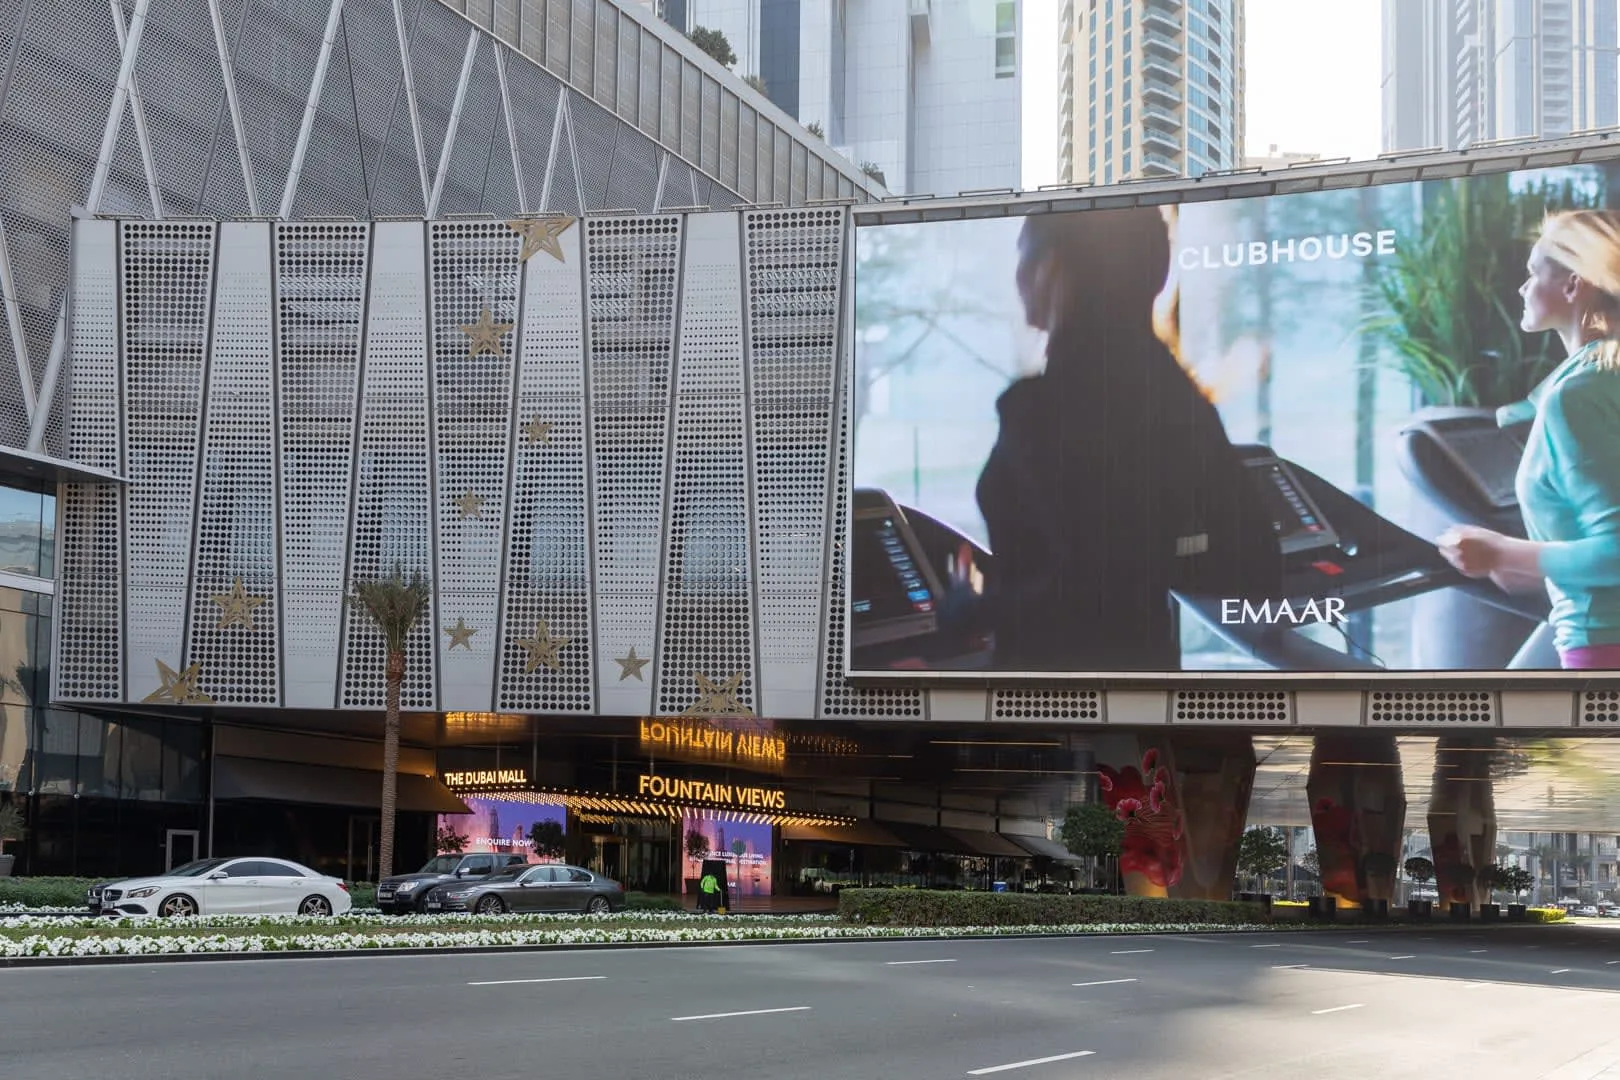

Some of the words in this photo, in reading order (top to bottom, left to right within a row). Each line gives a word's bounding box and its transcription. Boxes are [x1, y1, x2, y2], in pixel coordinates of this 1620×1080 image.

[1178, 229, 1396, 271] CLUBHOUSE
[1221, 597, 1349, 624] EMAAR
[444, 772, 464, 786] THE
[465, 771, 496, 785] DUBAI
[498, 769, 527, 783] MALL
[639, 775, 732, 804] FOUNTAIN
[736, 786, 785, 809] VIEWS
[476, 837, 511, 847] ENQUIRE
[512, 839, 532, 848] NOW
